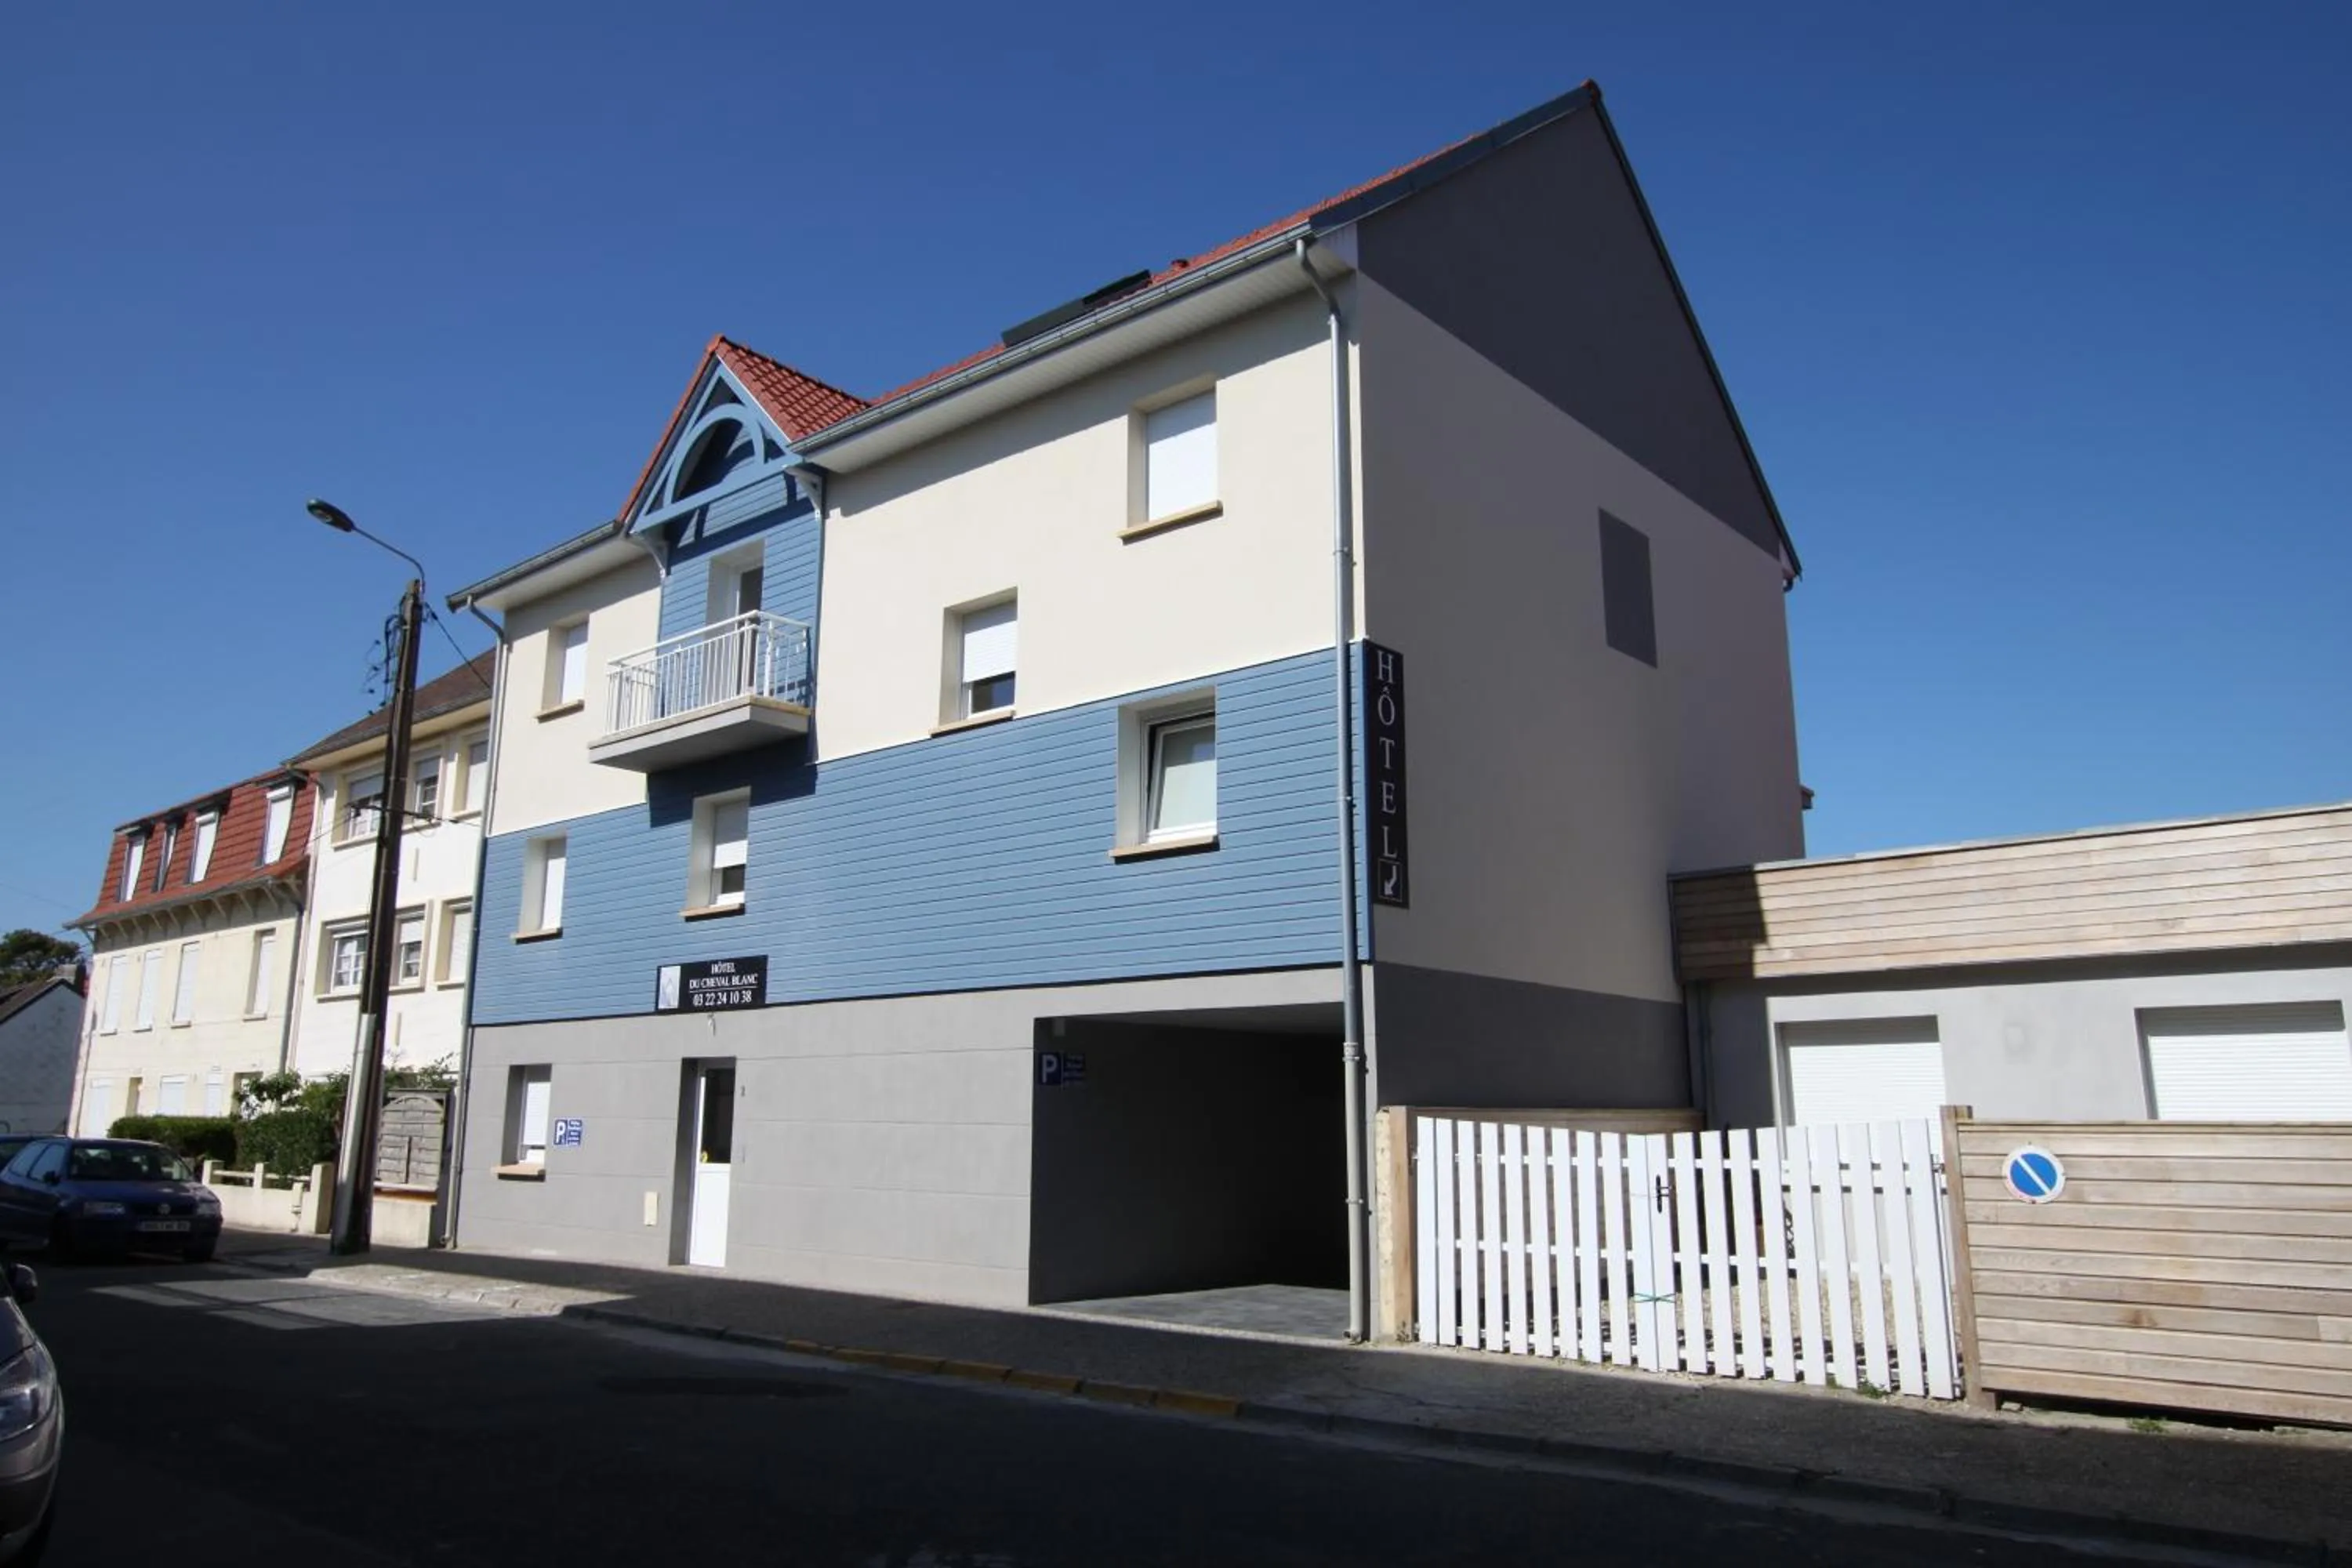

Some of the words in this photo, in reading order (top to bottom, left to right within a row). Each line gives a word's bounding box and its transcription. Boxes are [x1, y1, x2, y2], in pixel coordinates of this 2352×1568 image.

[689, 979, 700, 989] DU
[701, 976, 729, 988] CHEVAL
[731, 973, 758, 985] BLANC
[692, 993, 703, 1007] 03
[705, 993, 716, 1006] 22
[717, 991, 728, 1004] 24
[729, 990, 739, 1004] 10
[740, 989, 753, 1004] 38
[1042, 1054, 1058, 1083] P
[556, 1121, 566, 1143] P
